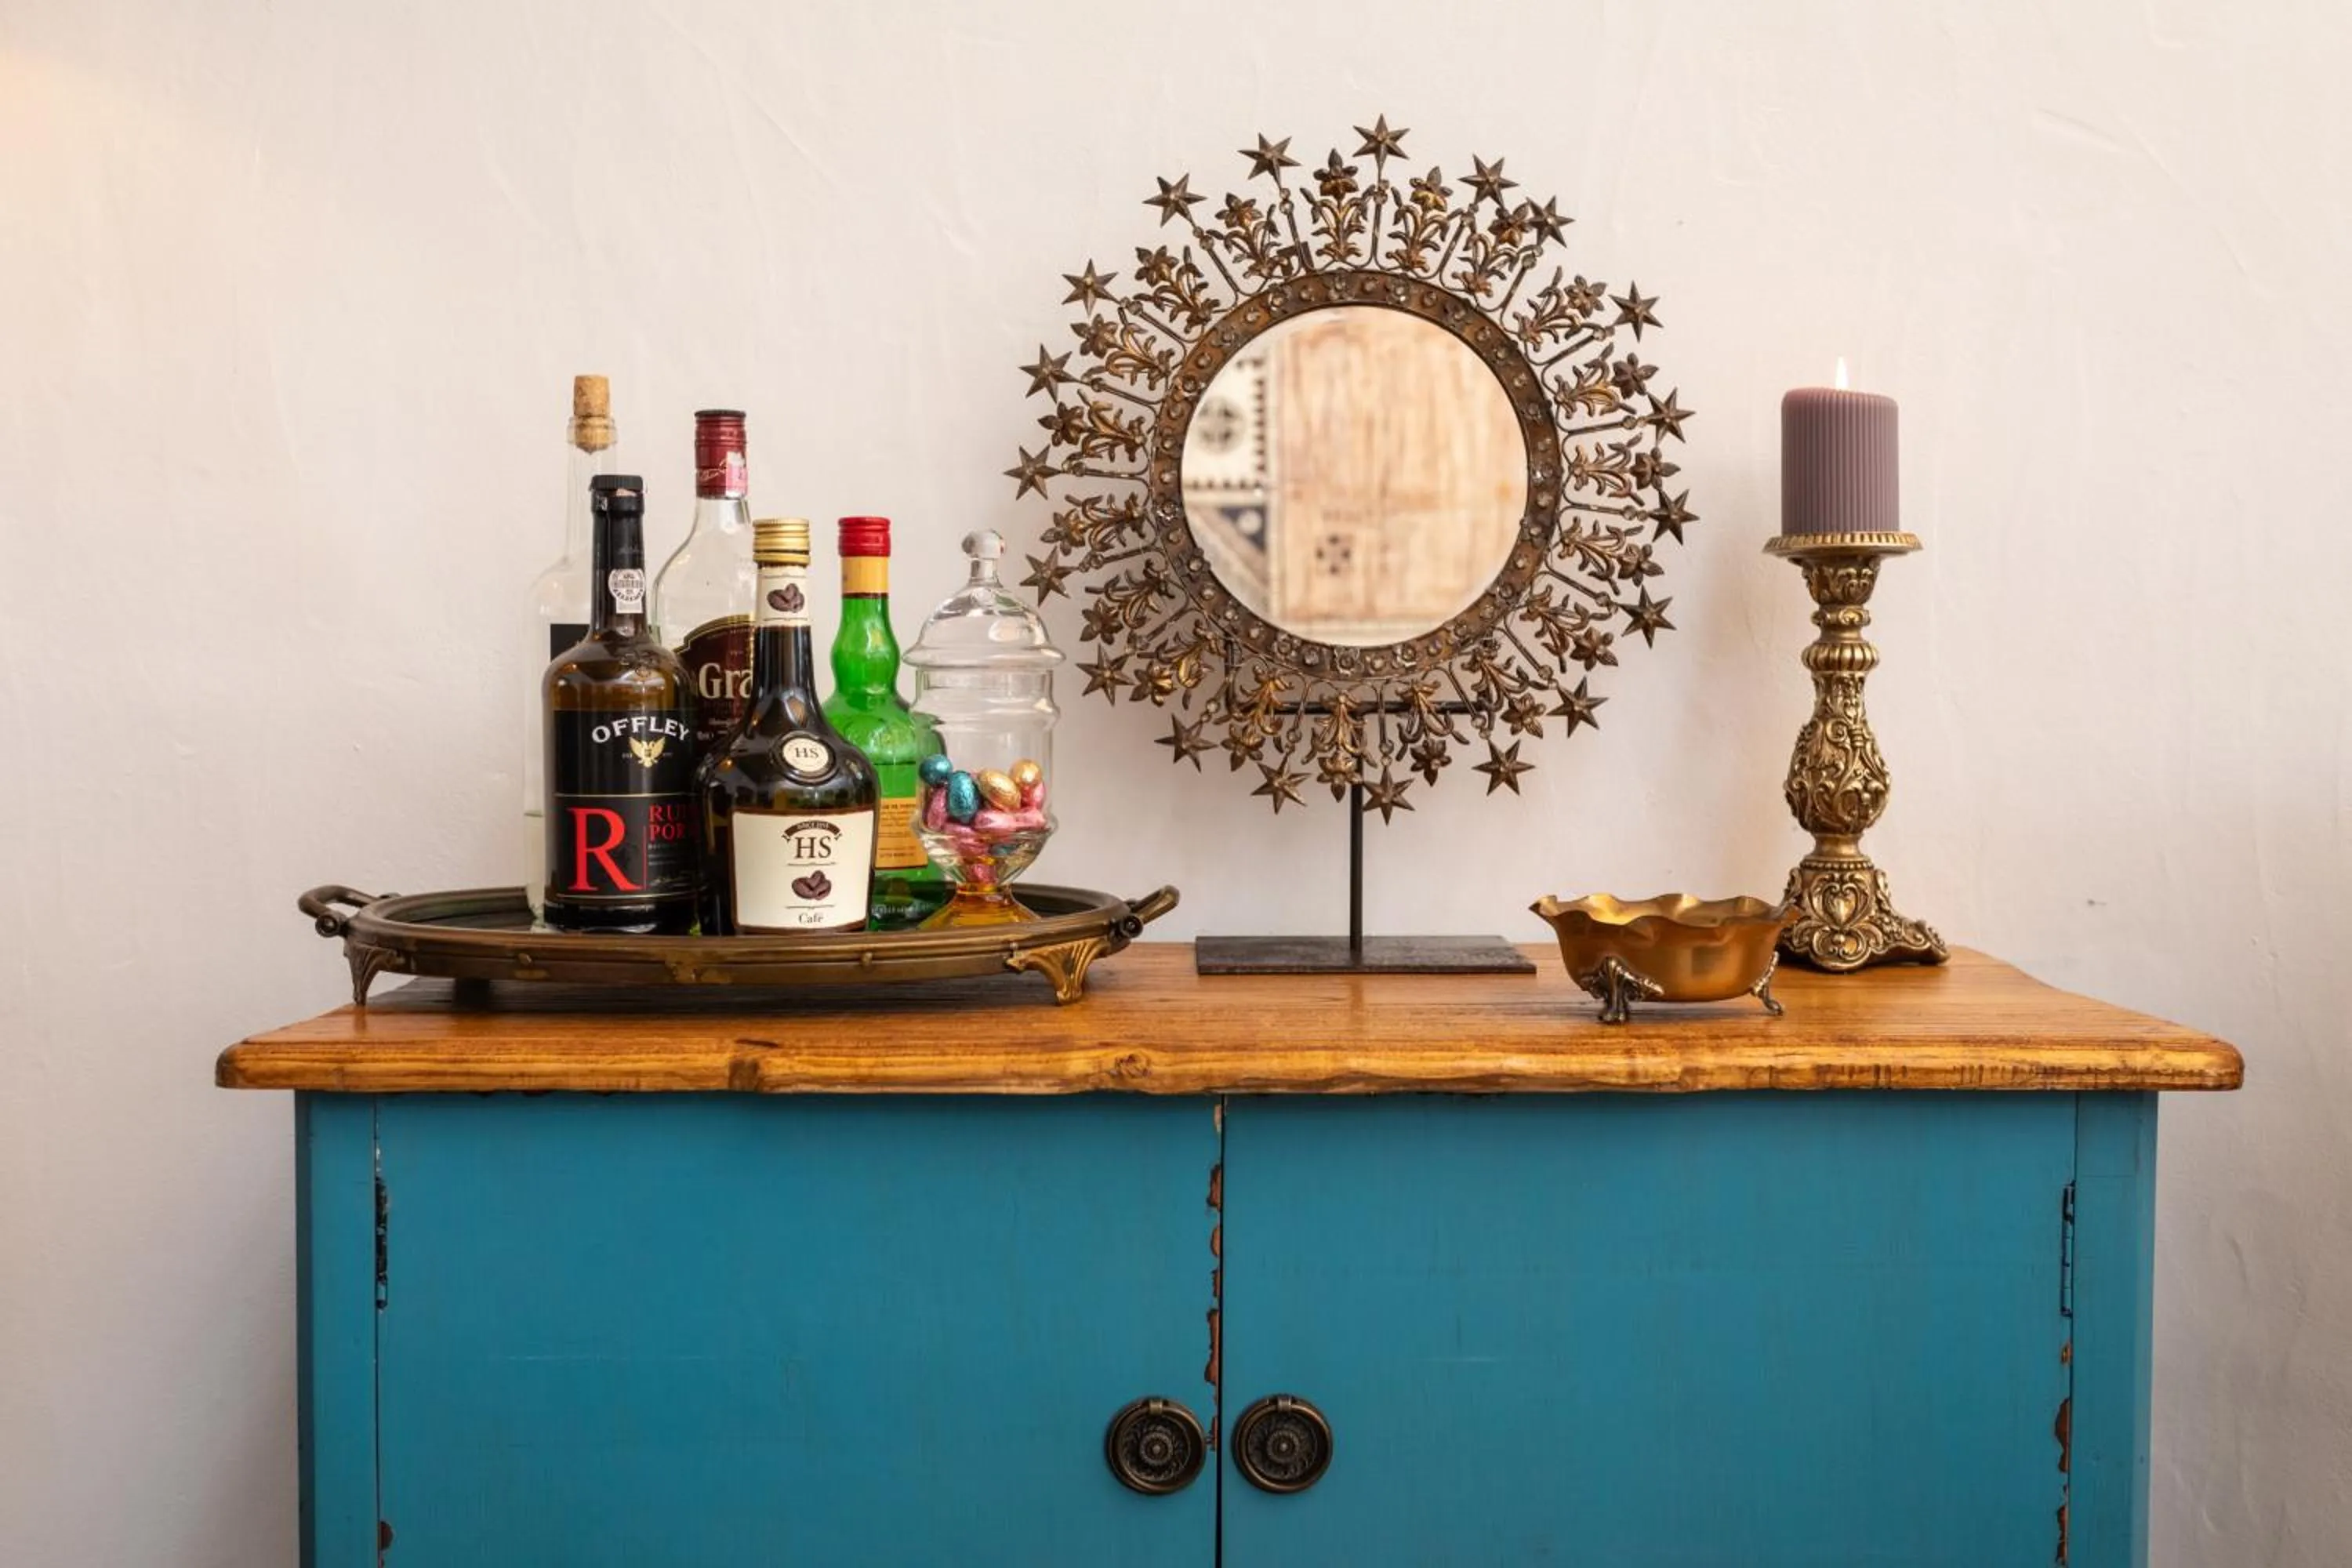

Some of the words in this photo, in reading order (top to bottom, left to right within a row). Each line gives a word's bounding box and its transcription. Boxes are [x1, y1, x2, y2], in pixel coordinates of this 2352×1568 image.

[591, 716, 690, 743] OFFLEY
[794, 746, 819, 759] HS
[565, 806, 644, 891] R
[793, 835, 833, 858] HS
